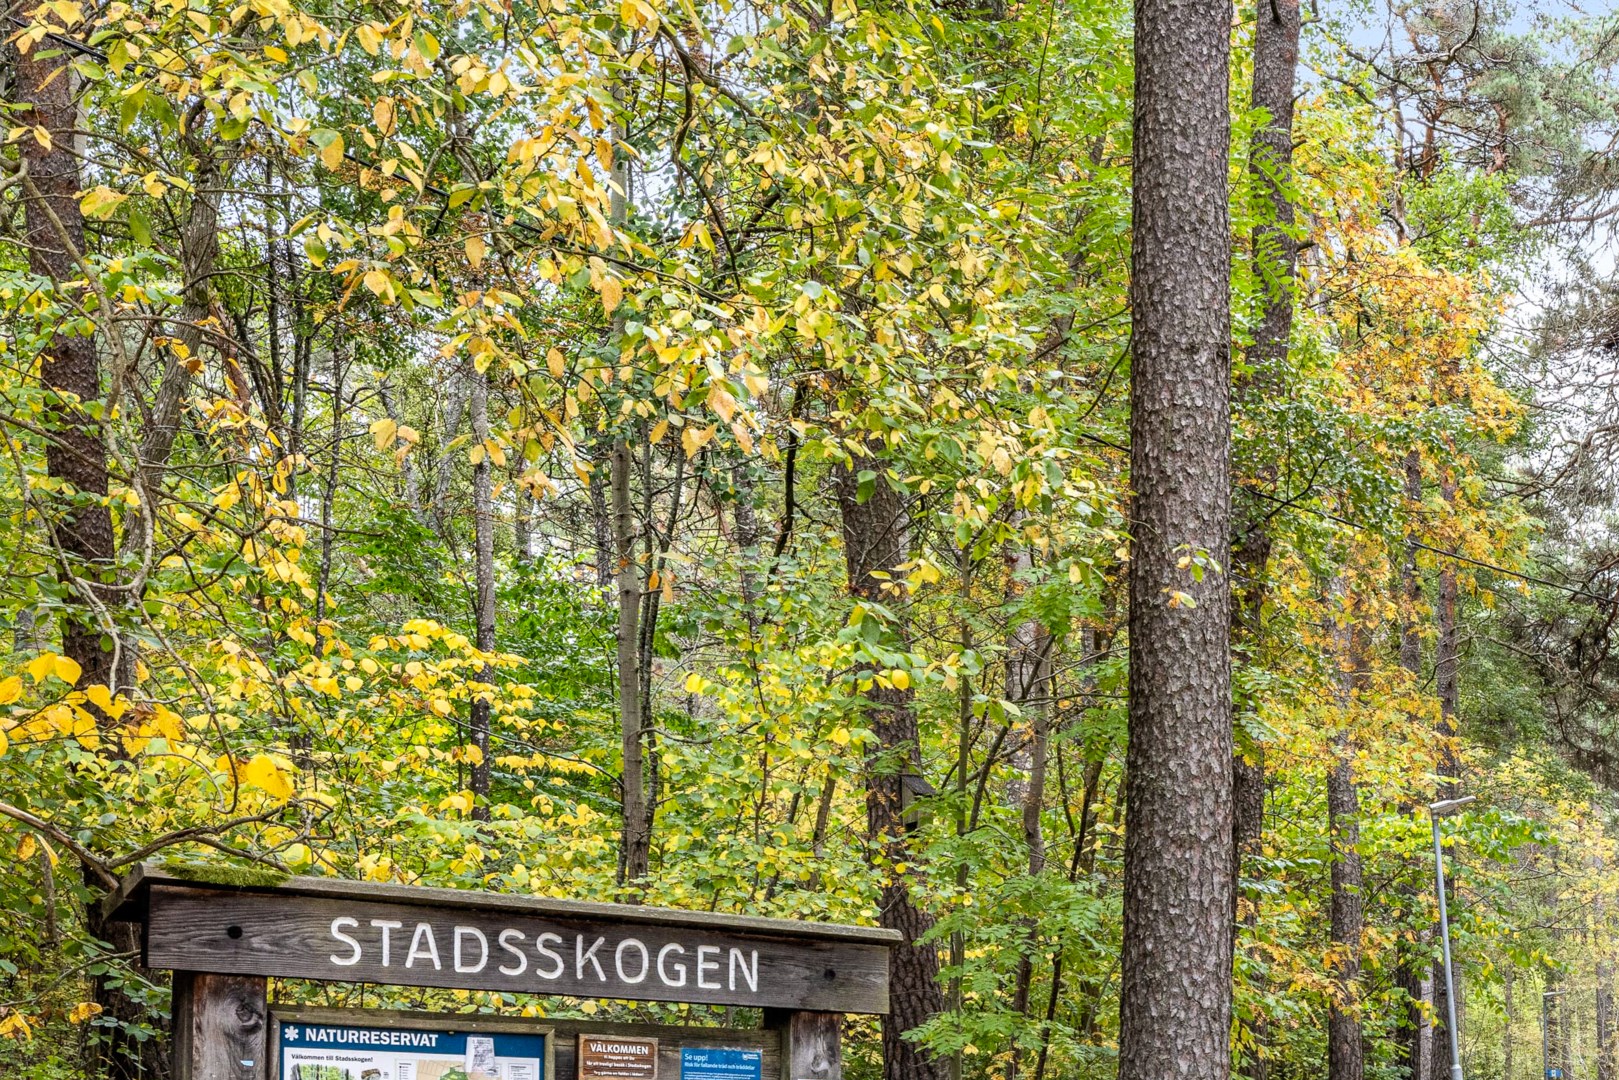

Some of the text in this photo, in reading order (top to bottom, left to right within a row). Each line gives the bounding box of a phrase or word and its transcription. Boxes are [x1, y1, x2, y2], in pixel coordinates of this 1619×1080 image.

[330, 916, 759, 993] STADSSKOGEN
[305, 1028, 439, 1047] NATURRESERVAT
[590, 1041, 649, 1055] VÄLKOMMEN
[291, 1053, 325, 1061] Välkommen
[335, 1055, 374, 1063] Stadsskogen!
[693, 1054, 708, 1062] upp!
